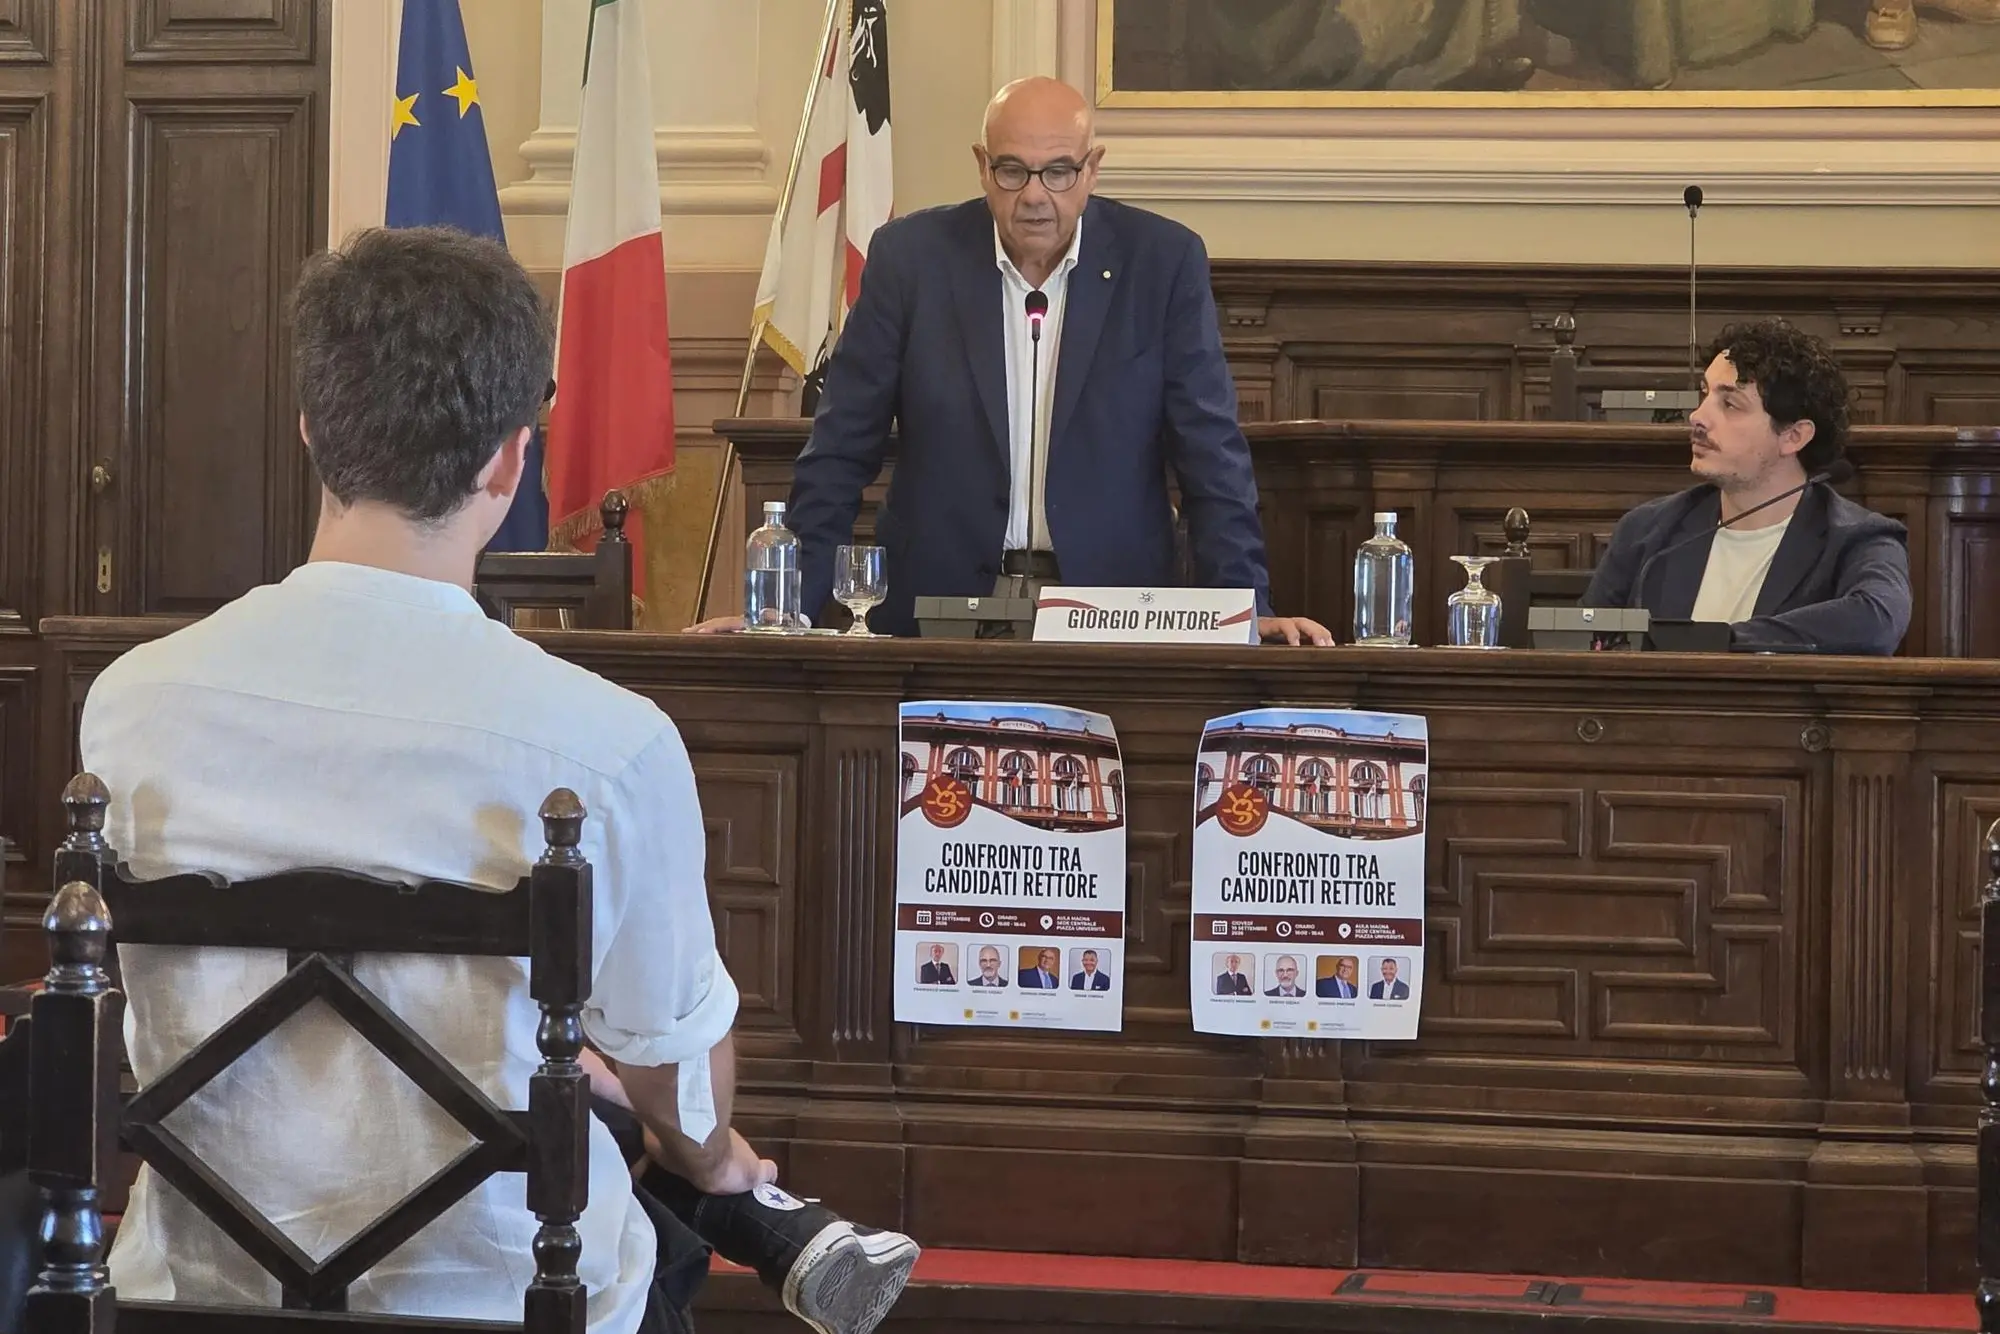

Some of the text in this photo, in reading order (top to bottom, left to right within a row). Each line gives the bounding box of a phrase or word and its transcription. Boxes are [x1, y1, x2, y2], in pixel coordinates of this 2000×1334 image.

[1068, 609, 1221, 630] GIORGIO PINTORE
[942, 842, 1082, 872] CONFRONTO TRA
[1238, 851, 1380, 879] CONFRONTO TRA
[925, 868, 1098, 899] CANDIDATI RETTORE
[1221, 877, 1396, 906] CANDIDATI RETTORE
